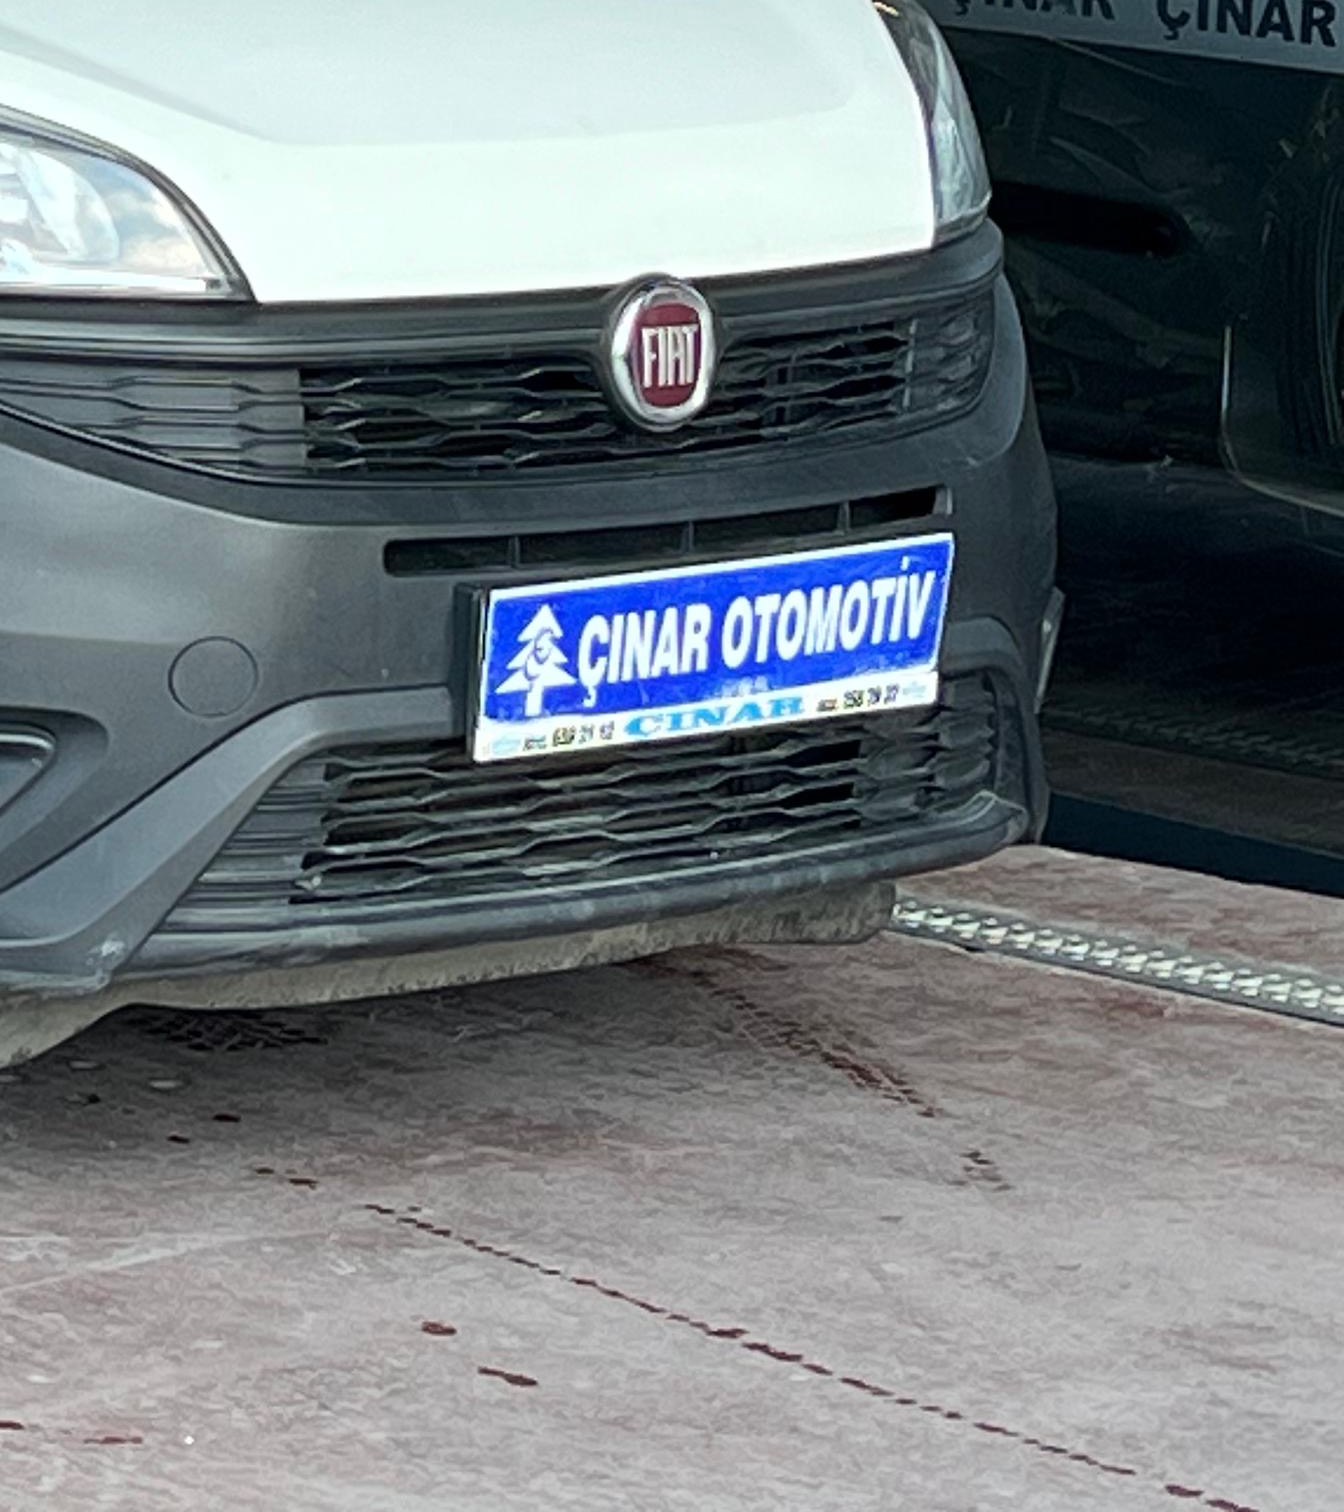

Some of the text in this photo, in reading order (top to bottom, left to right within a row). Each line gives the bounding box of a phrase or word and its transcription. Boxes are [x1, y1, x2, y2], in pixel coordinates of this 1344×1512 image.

[641, 323, 700, 389] FIAT
[577, 556, 937, 707] ÇINAR OTOMOTİV
